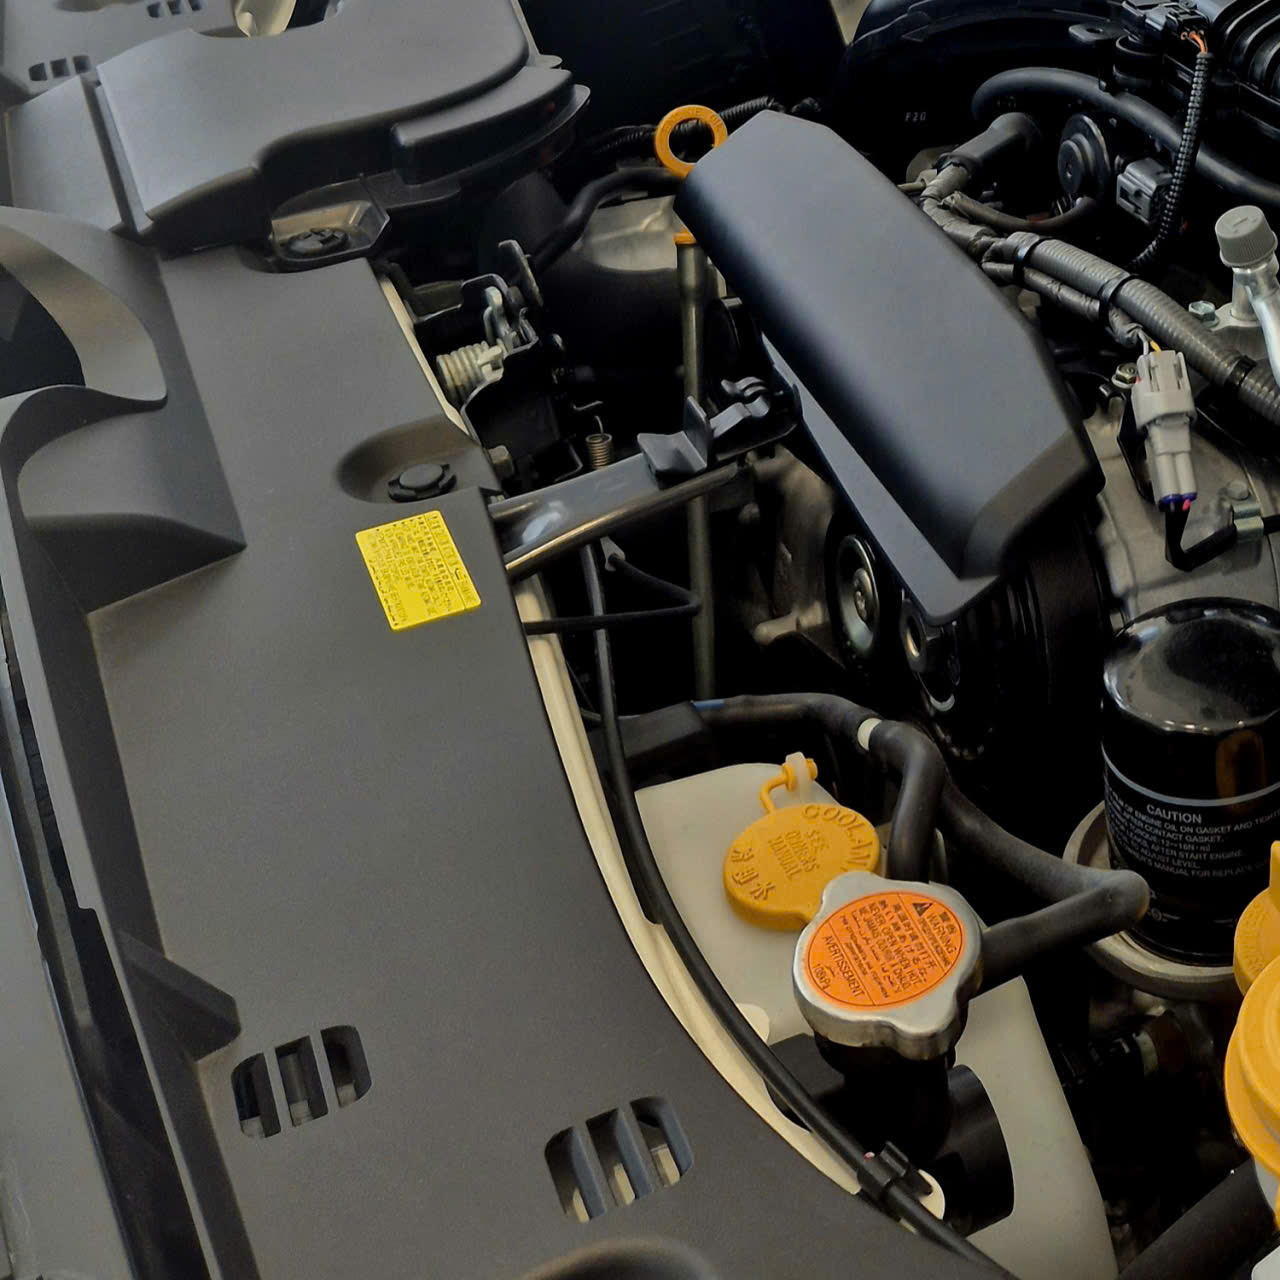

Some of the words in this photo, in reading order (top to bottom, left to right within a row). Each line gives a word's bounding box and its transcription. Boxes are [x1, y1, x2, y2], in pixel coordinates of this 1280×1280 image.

[1146, 804, 1202, 824] CAUTION
[1144, 824, 1184, 840] CONTACT
[1180, 826, 1194, 834] ON
[1195, 826, 1232, 834] GASKET
[1233, 821, 1253, 831] AND
[1178, 852, 1208, 860] START
[823, 935, 866, 997] AVERTISSEMENT
